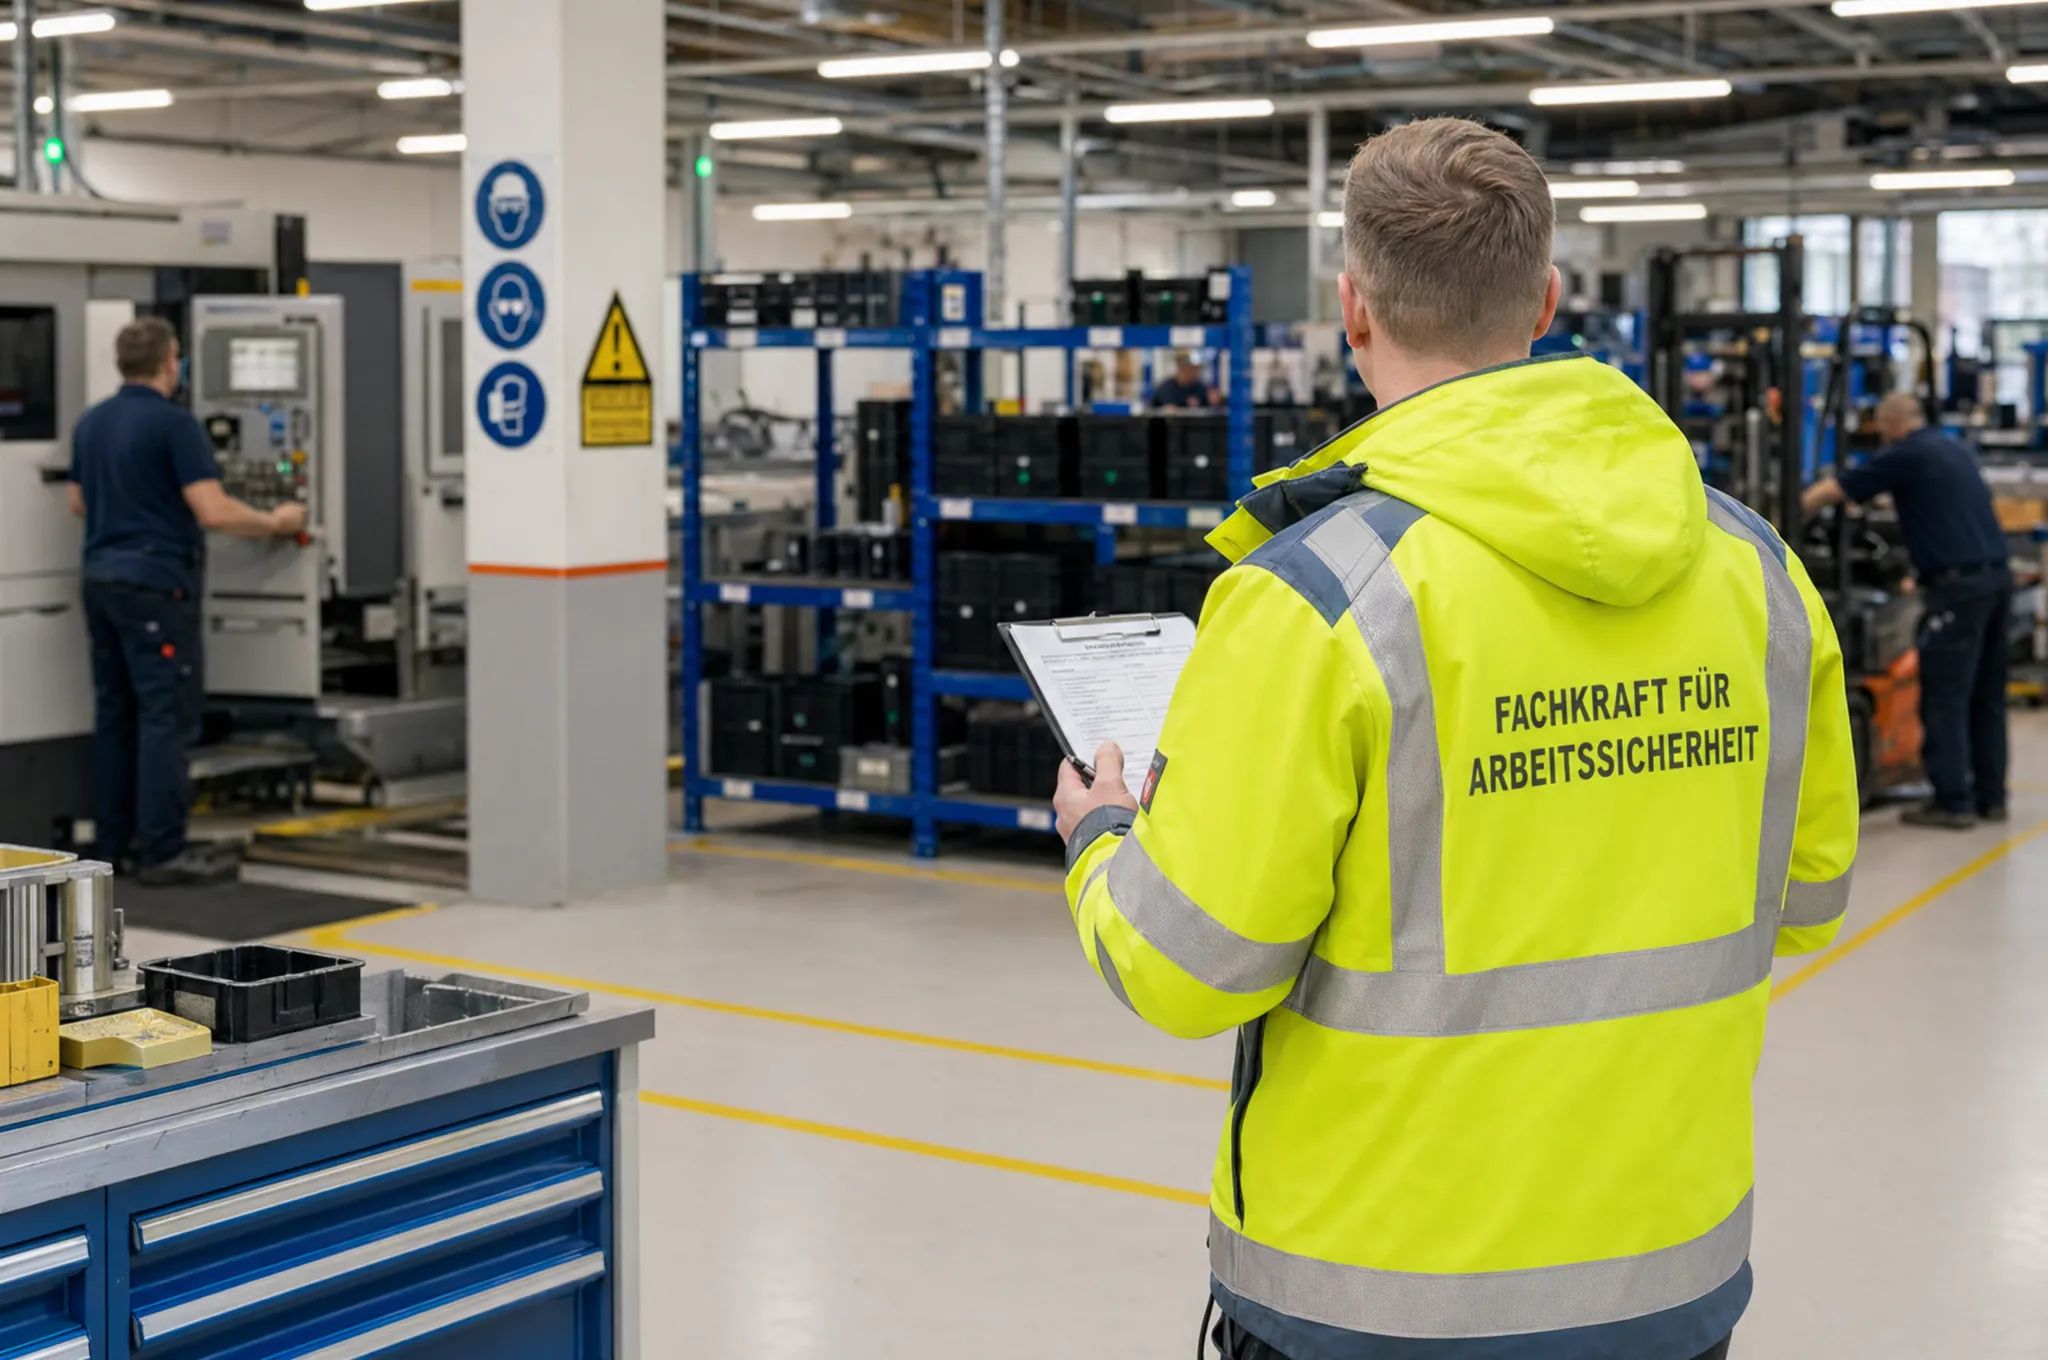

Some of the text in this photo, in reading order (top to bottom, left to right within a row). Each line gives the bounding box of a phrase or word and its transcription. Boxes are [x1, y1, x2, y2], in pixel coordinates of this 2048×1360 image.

[1495, 666, 1731, 734] FACHKRAFT FÜR
[1469, 725, 1759, 796] ARBEITSSICHERHEIT
